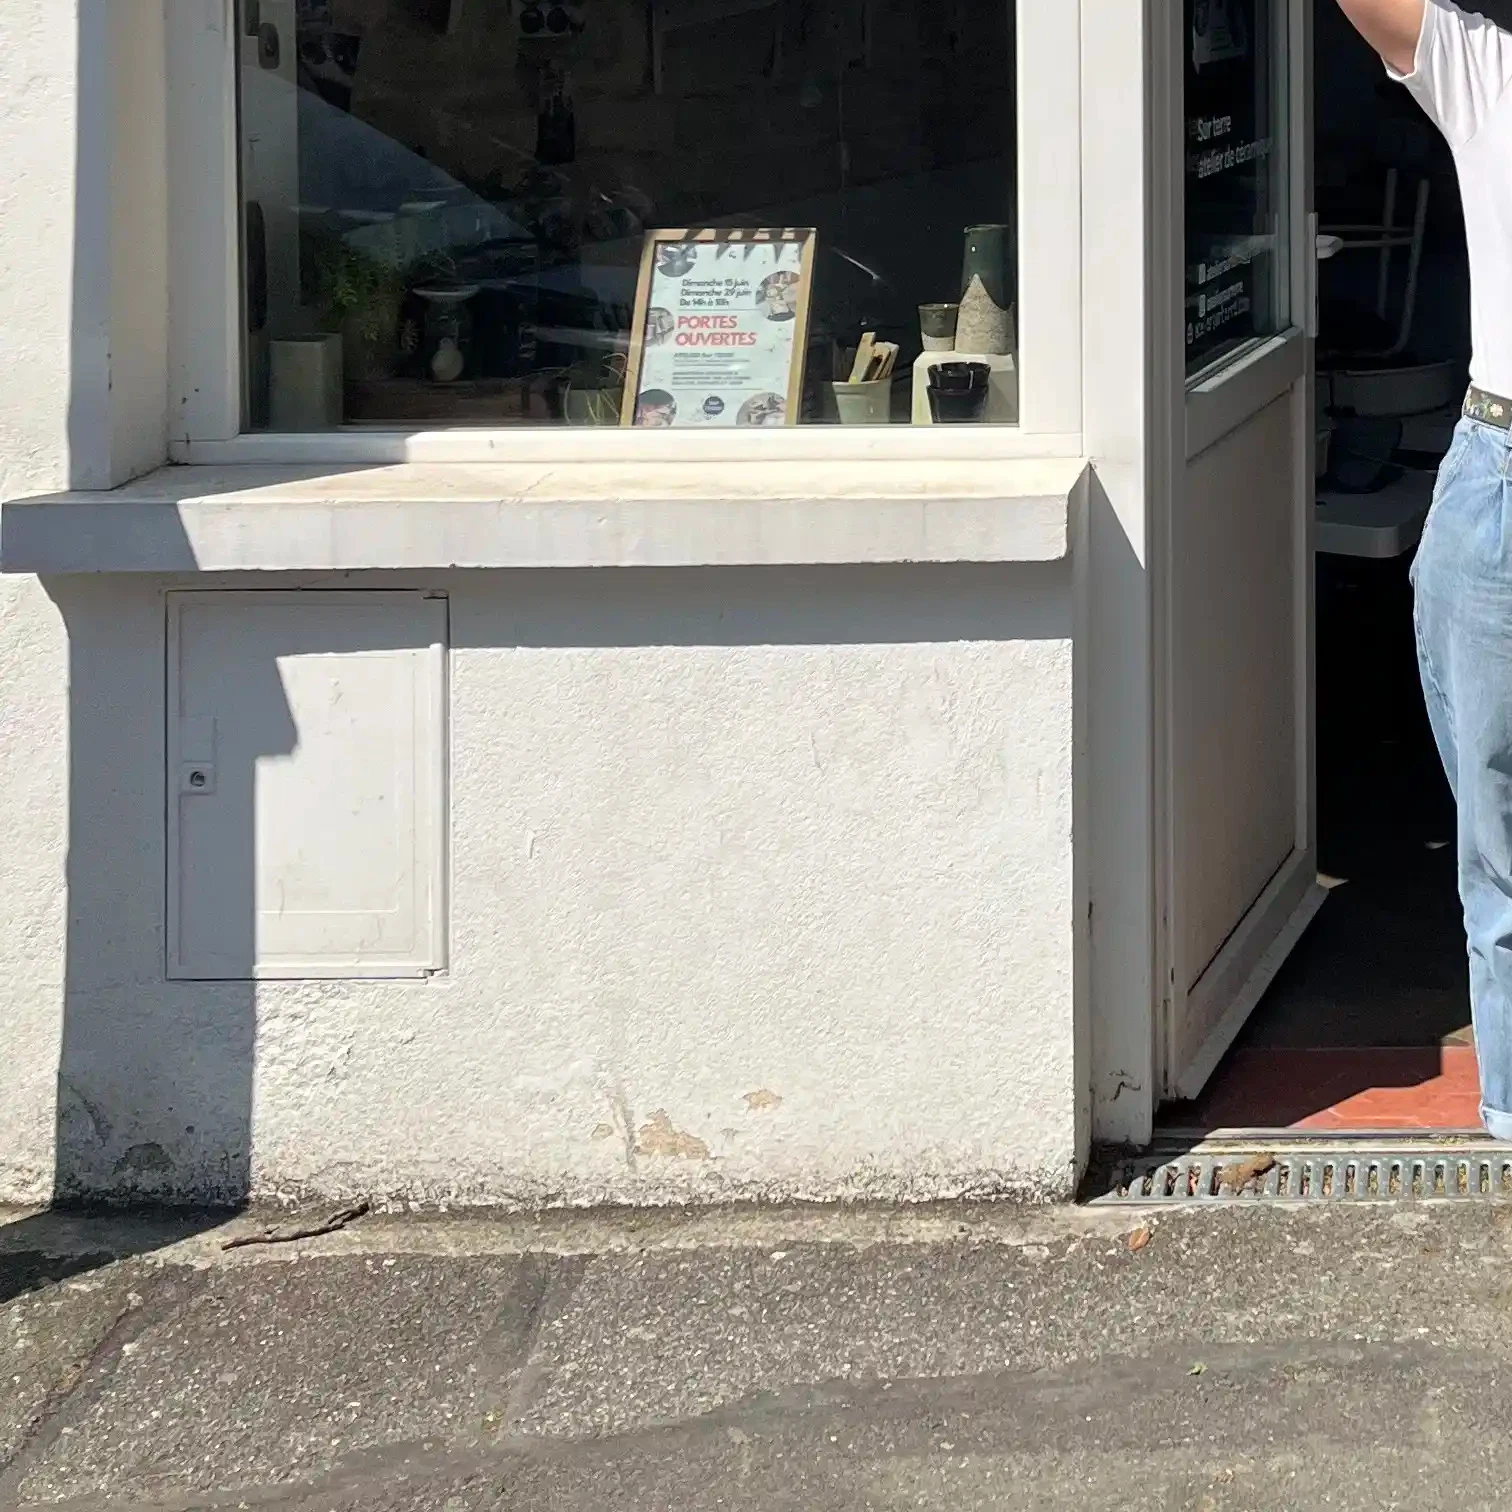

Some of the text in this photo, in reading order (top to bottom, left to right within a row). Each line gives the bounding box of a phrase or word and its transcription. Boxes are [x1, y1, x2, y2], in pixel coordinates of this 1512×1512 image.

[682, 278, 723, 287] Dimanche
[734, 278, 750, 289] juin
[680, 288, 722, 296] Dimanche
[735, 288, 752, 298] juin
[677, 315, 738, 329] PORTES
[675, 332, 757, 346] OUVERTES
